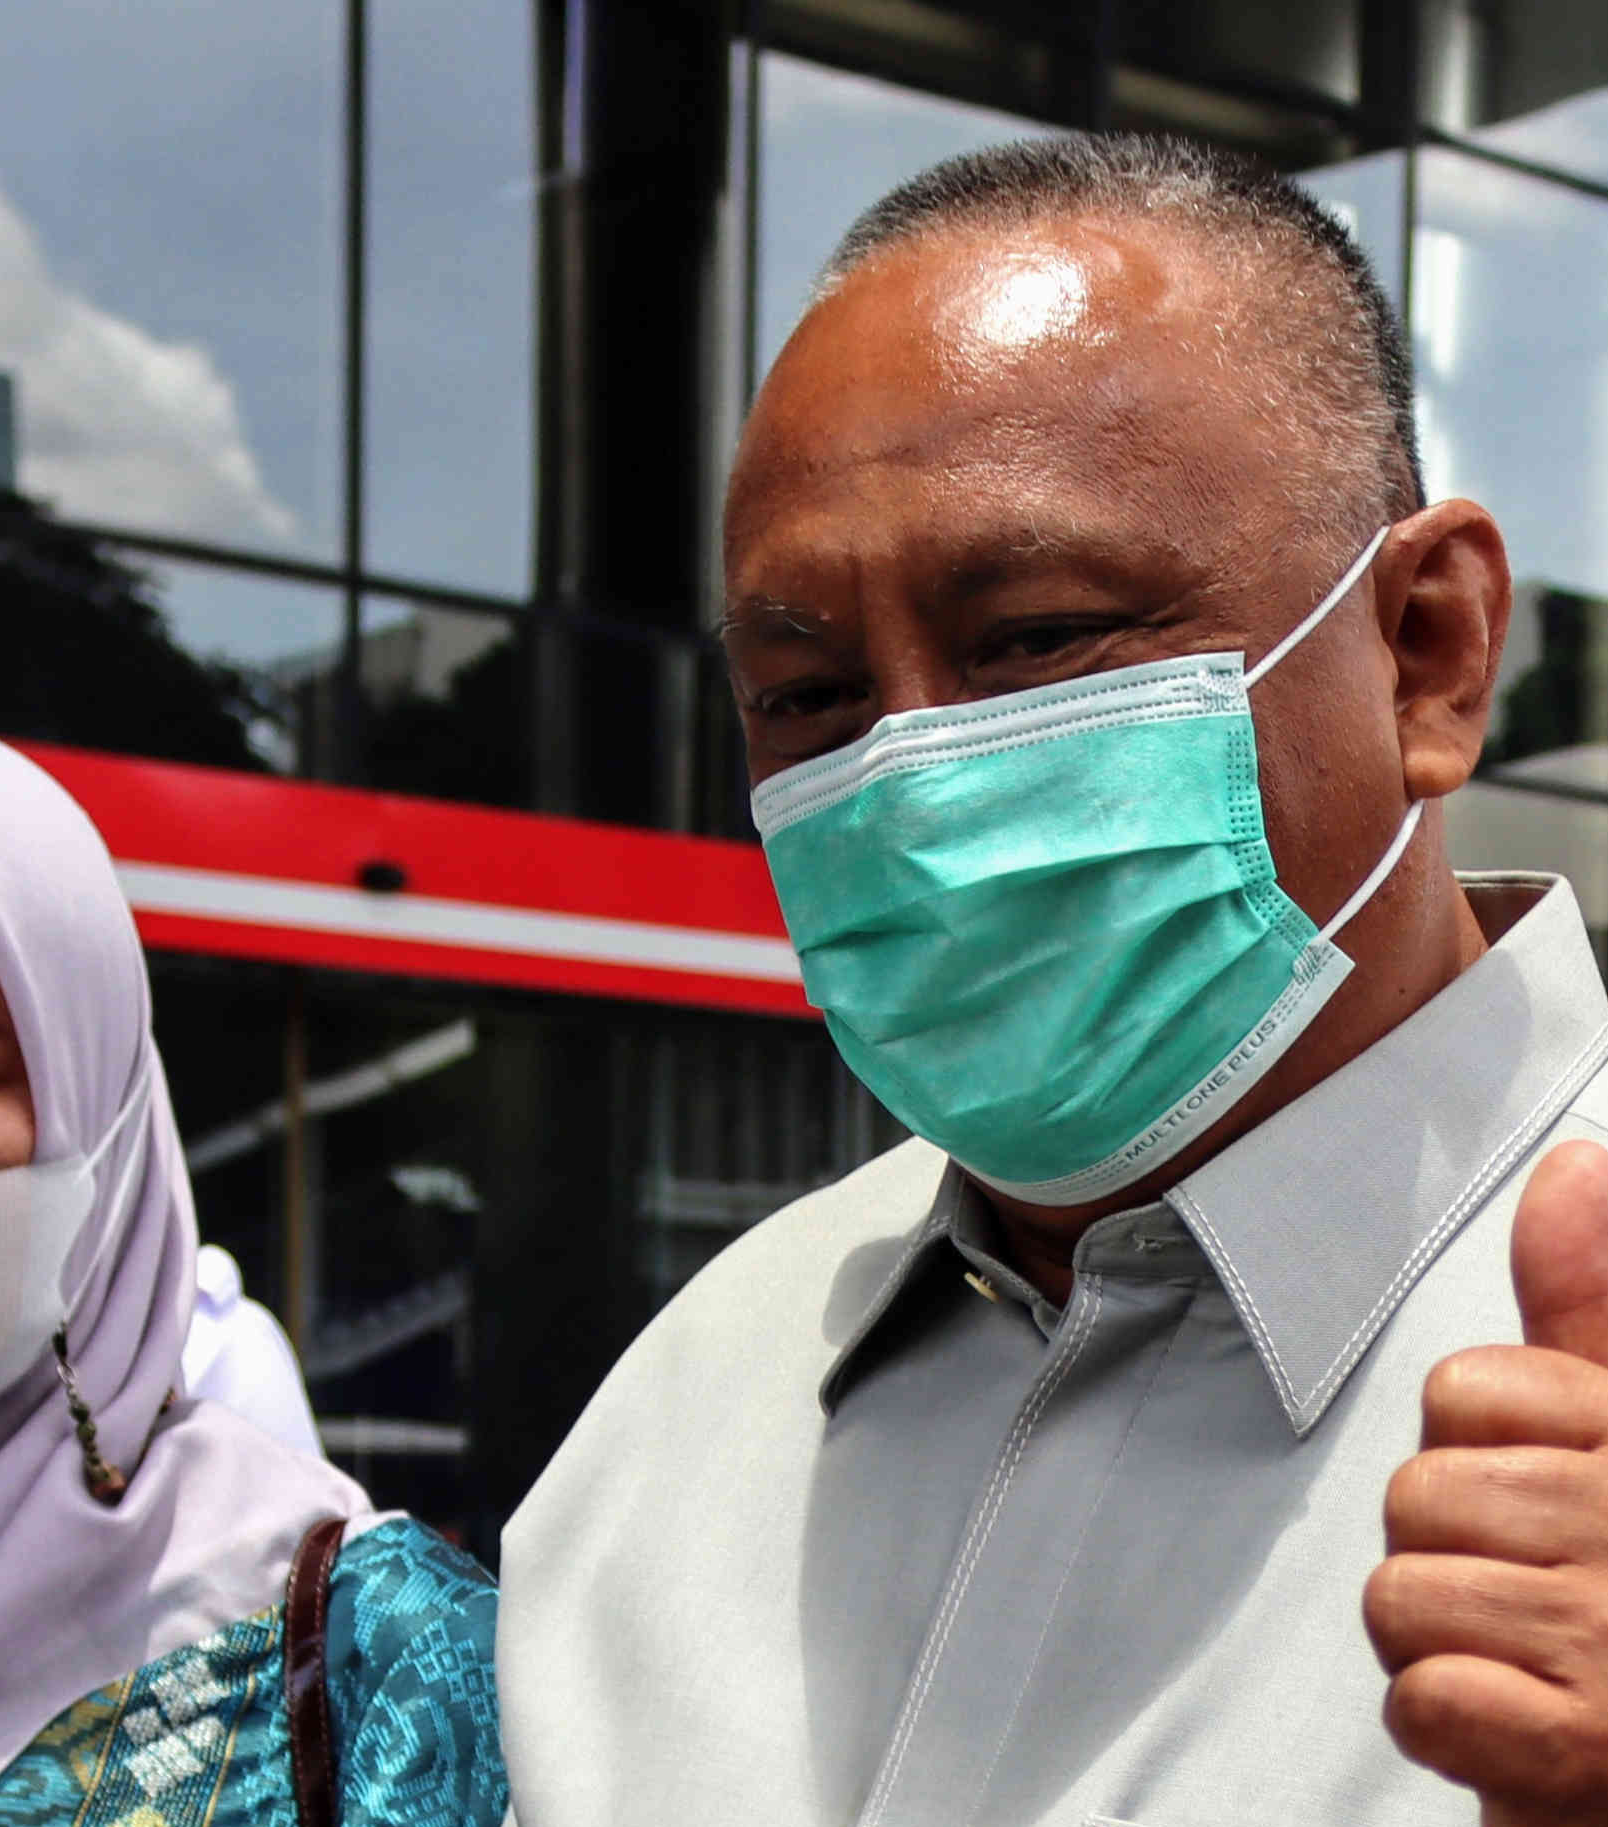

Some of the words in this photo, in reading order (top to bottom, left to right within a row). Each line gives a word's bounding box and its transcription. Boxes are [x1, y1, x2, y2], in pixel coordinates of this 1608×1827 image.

[1125, 1110, 1186, 1161] MULTI
[1186, 1071, 1231, 1110] ONE
[1227, 1020, 1276, 1072] PLUS
